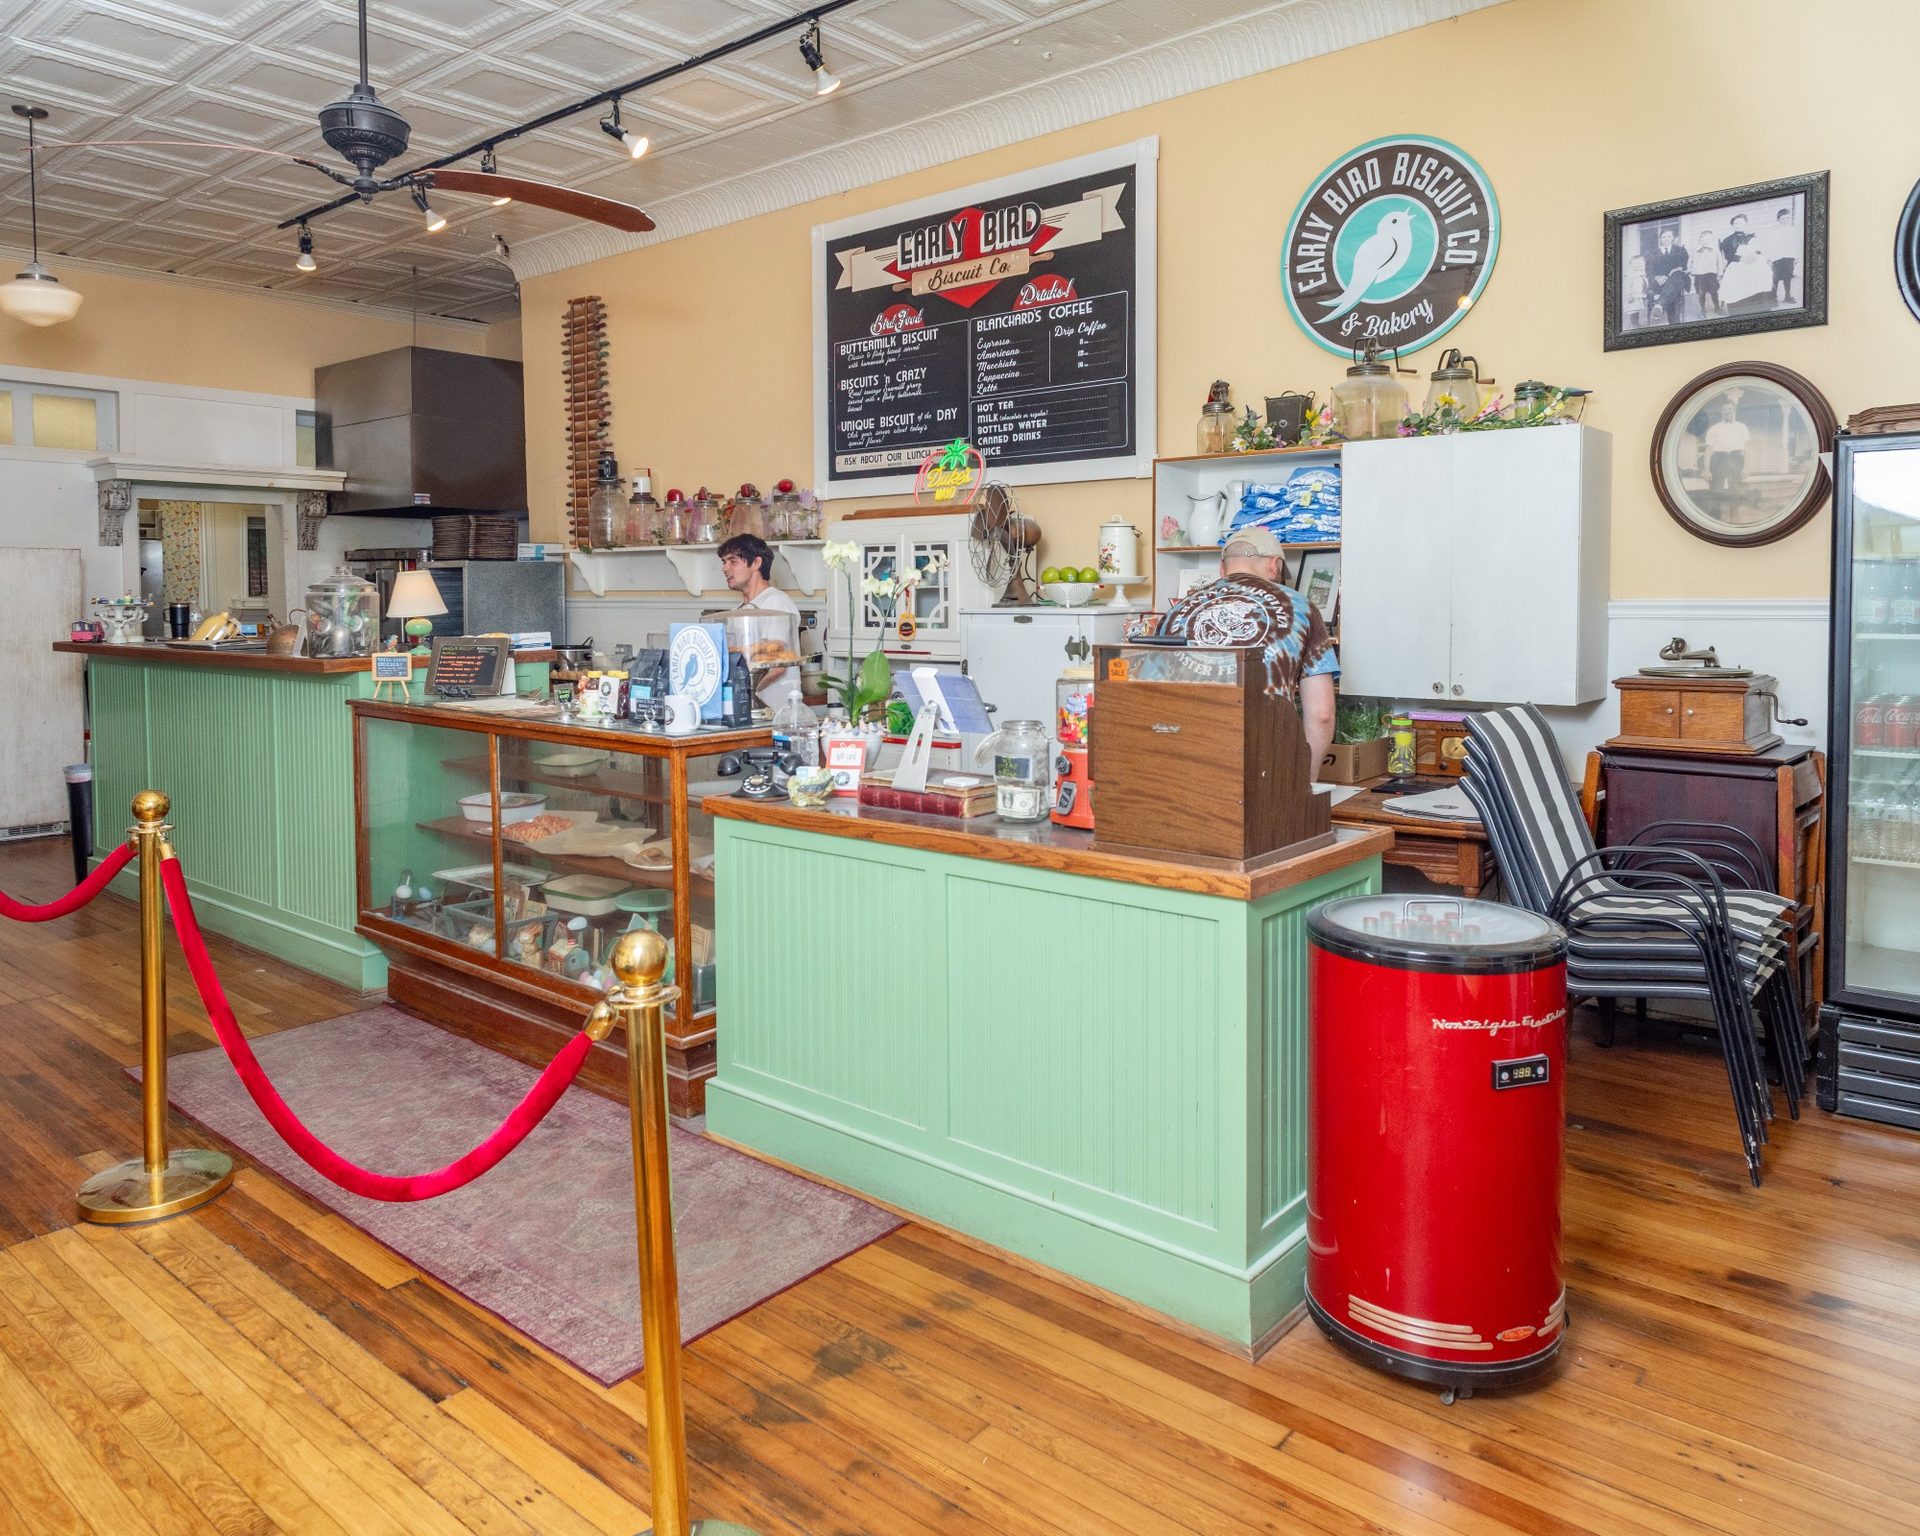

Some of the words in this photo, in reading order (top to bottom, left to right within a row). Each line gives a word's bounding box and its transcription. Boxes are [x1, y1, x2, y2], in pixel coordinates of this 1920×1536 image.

[1296, 212, 1334, 294] EARLY
[1322, 157, 1382, 216] BIRD
[1392, 152, 1479, 224] BISCUIT
[1440, 229, 1480, 272] CO.
[897, 217, 968, 272] EARLY
[980, 201, 1043, 254] BIRD
[928, 266, 983, 292] Biscuit
[989, 256, 1012, 277] Co.
[1020, 277, 1075, 307] Drinks!
[977, 309, 1042, 332] BLANCHARD'S
[1049, 300, 1093, 320] COFFEE
[1340, 313, 1362, 336] &
[1362, 298, 1433, 338] Bakery
[1054, 325, 1075, 337] Drip
[1078, 320, 1107, 336] Coffee
[840, 335, 896, 356] BUTTERMILK
[902, 328, 939, 345] BISCUIT
[976, 337, 1011, 350] Espresso
[976, 348, 1020, 360] Americano
[976, 358, 1017, 372] Macchiato
[840, 374, 879, 391] BISCUITS
[896, 367, 927, 382] CRAZY
[977, 370, 1020, 383] Cappuccino
[977, 402, 994, 413] HOT
[998, 400, 1014, 410] TEA
[840, 417, 875, 432] UNIQUE
[879, 412, 915, 428] BISCUIT
[923, 411, 932, 420] the
[937, 407, 958, 421] DAY
[977, 413, 999, 424] MILK
[977, 422, 1014, 435] BOTTLED
[1018, 418, 1047, 430] WATER
[977, 434, 1009, 446] CANNED
[1012, 430, 1041, 442] DRINKS
[844, 457, 857, 466] ASK
[860, 454, 883, 465] ABOUT
[887, 452, 902, 462] OUR
[906, 449, 931, 460] LUNCH
[980, 446, 1001, 456] JUICE
[1241, 585, 1288, 629] VIRGINIA
[1110, 669, 1125, 677] SALE
